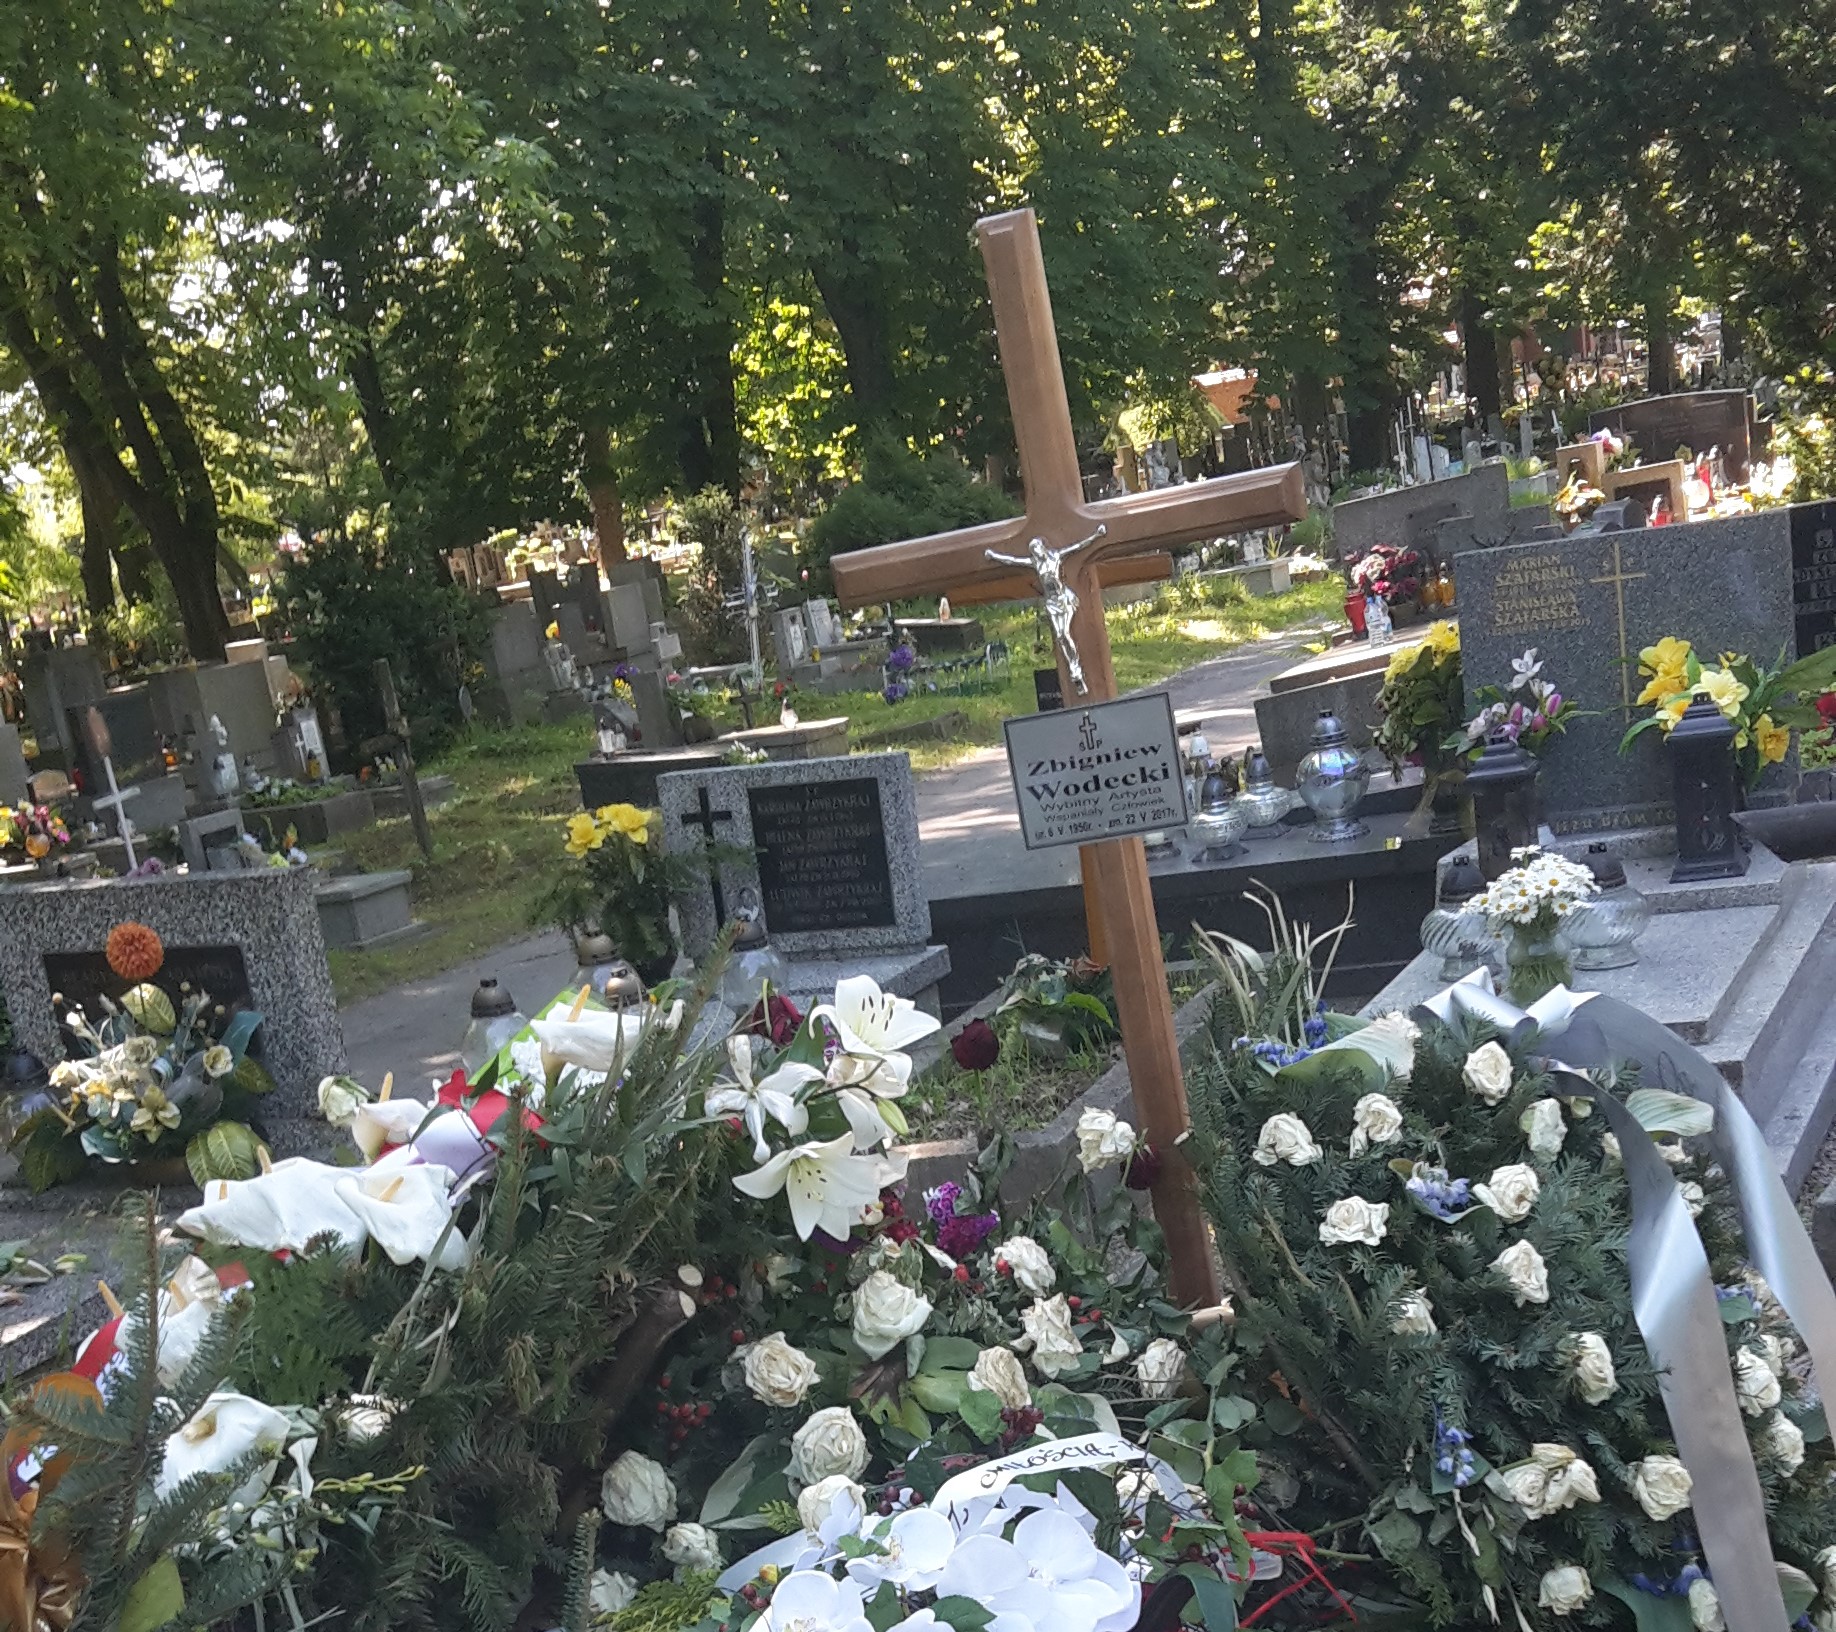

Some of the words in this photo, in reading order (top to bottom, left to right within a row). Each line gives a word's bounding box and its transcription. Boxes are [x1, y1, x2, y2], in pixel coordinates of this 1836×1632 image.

[1027, 743, 1162, 777] Zbigniew
[1026, 762, 1170, 802] Wodecki
[1040, 797, 1100, 813] Wybitny
[1108, 786, 1162, 802] Artysta
